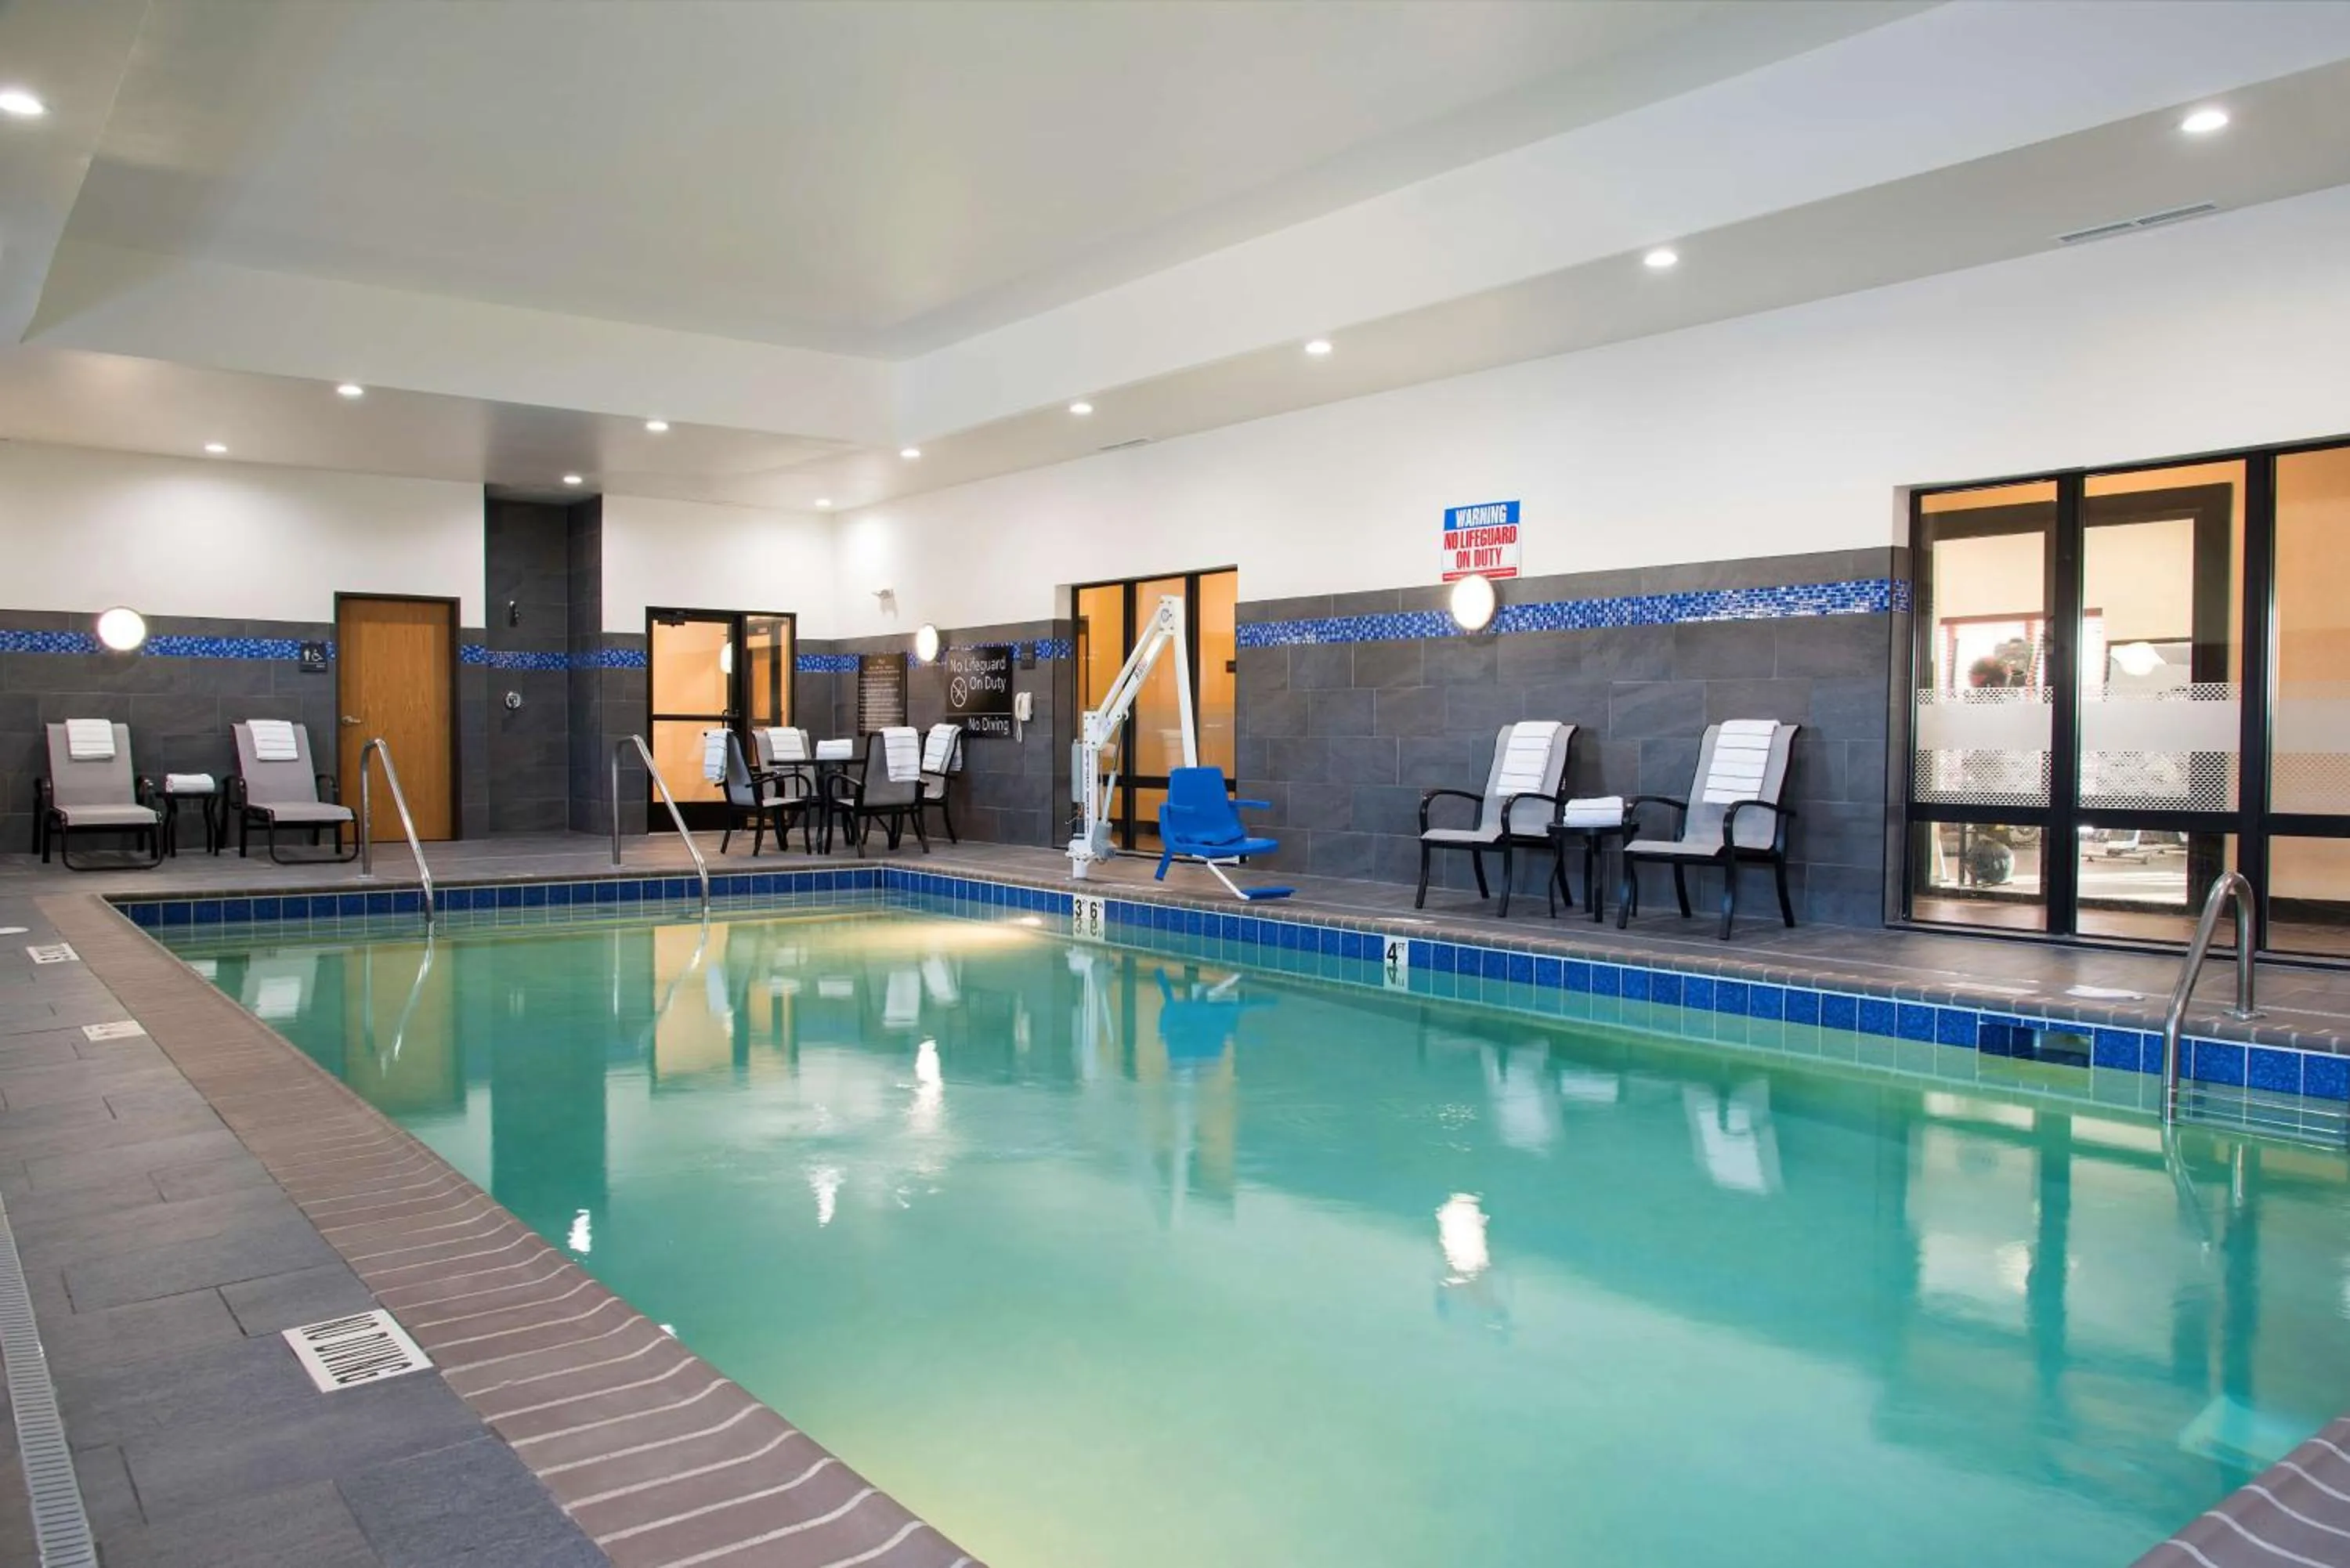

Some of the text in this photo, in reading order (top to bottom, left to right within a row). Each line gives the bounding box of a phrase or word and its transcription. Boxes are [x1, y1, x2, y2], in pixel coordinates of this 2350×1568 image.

[1456, 504, 1507, 528] WARNING
[1444, 526, 1517, 551] NO LIFEGUARD
[1456, 547, 1502, 569] ON DUTY
[950, 658, 963, 674] No
[964, 656, 1007, 674] Lifeguard
[969, 676, 1007, 693] On Duty
[968, 717, 1010, 735] No Diving
[1076, 899, 1097, 919] 3 6
[1386, 941, 1397, 964] 4
[300, 1313, 413, 1384] NO DIVING
